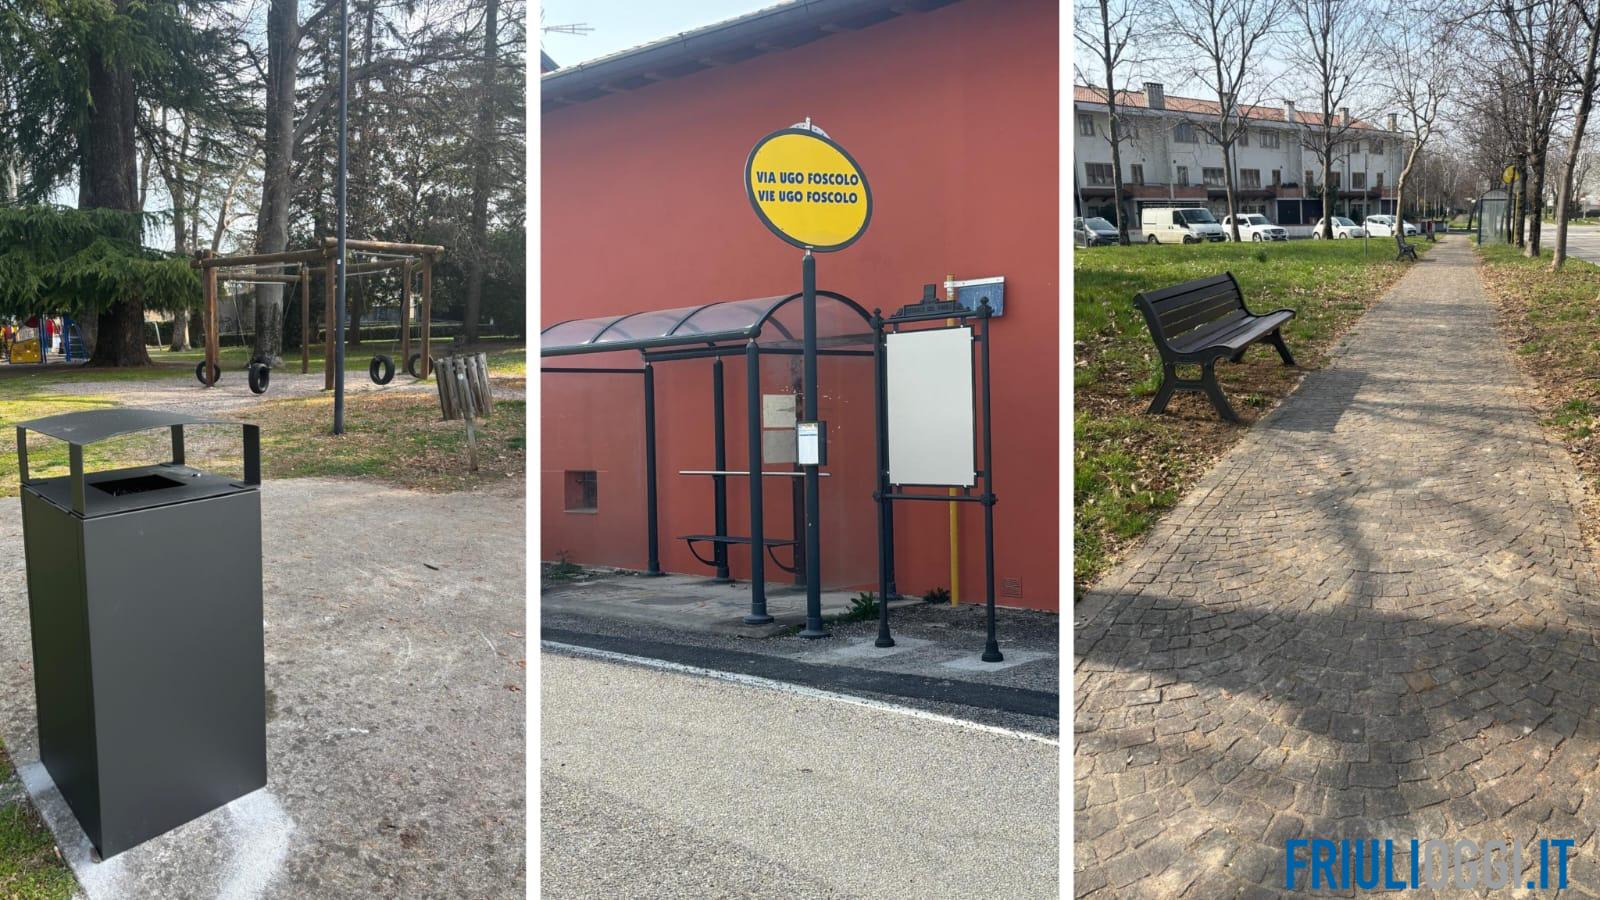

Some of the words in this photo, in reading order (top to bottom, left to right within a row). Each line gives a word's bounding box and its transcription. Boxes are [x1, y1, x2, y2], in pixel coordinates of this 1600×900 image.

[756, 171, 776, 183] VIA
[780, 172, 804, 183] UGO
[808, 173, 859, 185] FOSCOLO
[758, 190, 775, 202] VIE
[779, 190, 803, 202] UGO
[807, 191, 858, 203] FOSCOLO
